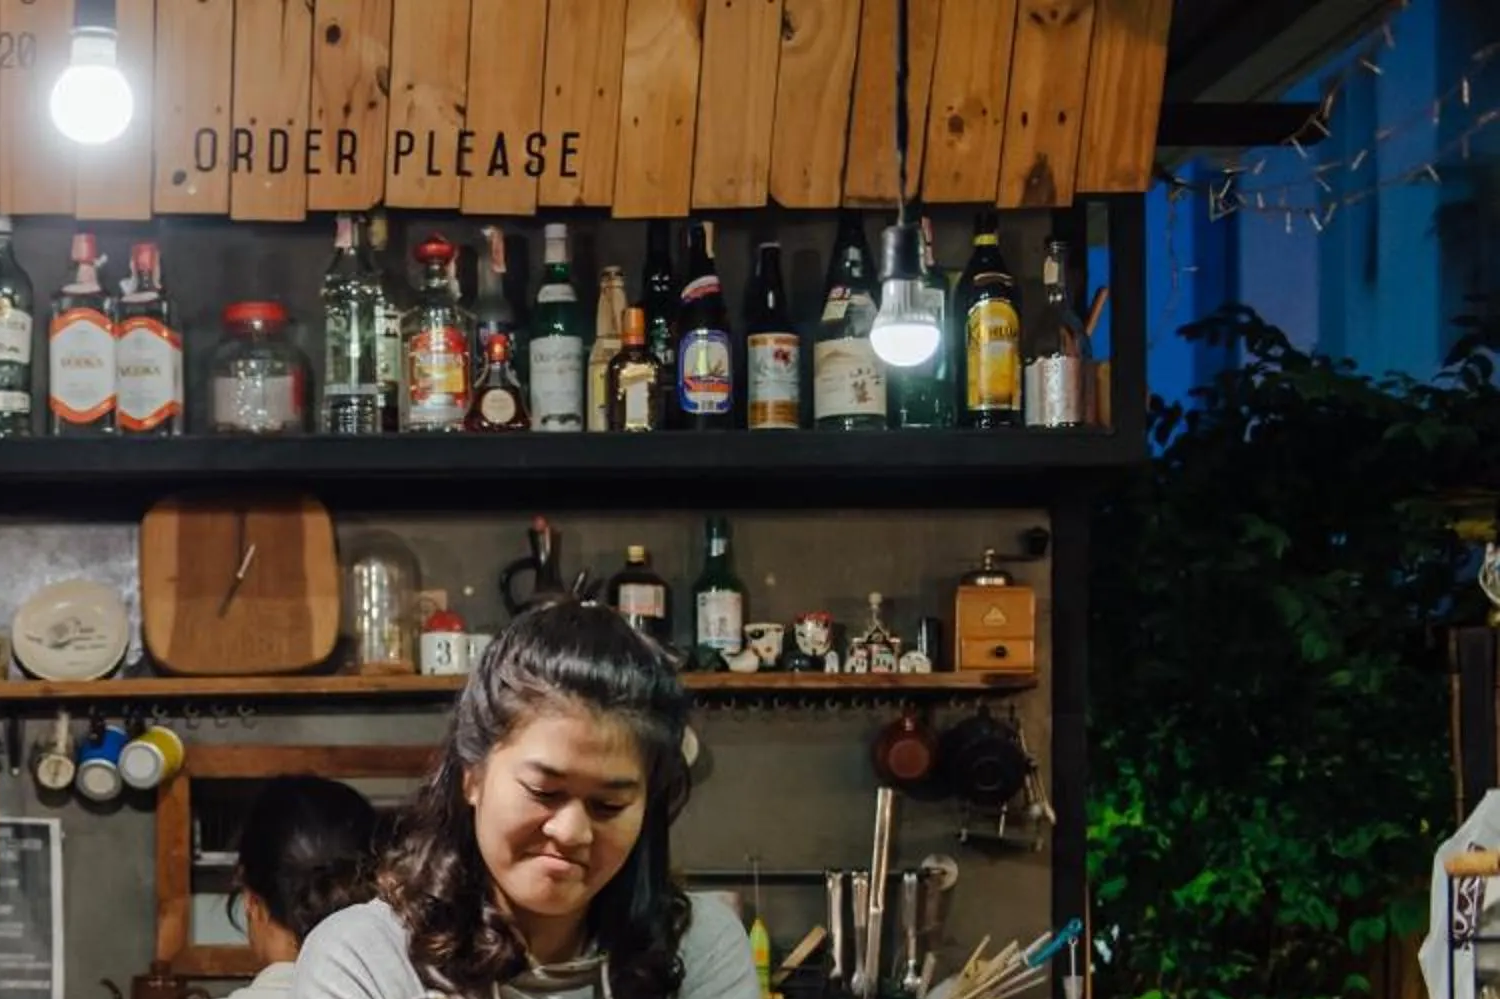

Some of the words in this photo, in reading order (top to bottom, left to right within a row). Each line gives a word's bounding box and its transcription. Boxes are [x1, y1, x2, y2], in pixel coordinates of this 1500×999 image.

[194, 128, 357, 174] ORDER
[393, 130, 581, 177] PLEASE
[437, 639, 451, 665] 3
